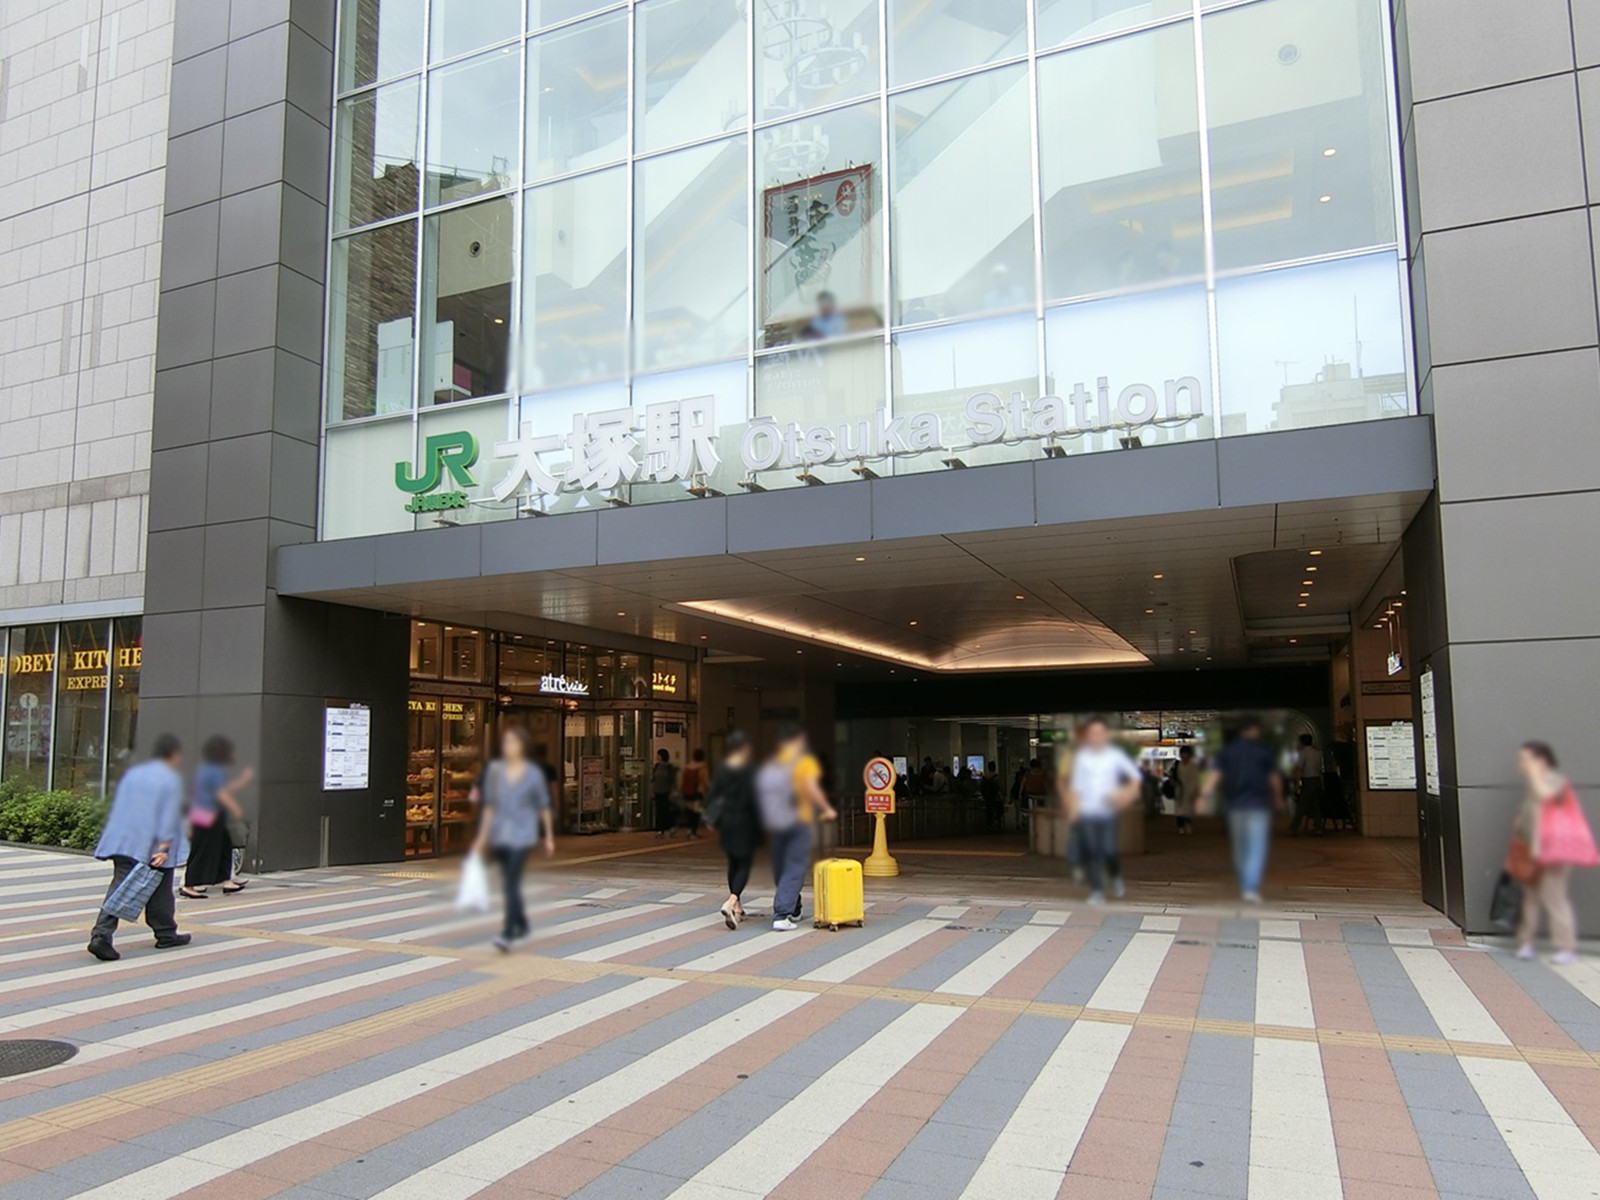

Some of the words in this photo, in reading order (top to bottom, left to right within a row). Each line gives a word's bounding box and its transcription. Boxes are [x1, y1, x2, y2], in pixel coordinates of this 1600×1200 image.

[395, 430, 479, 495] JR
[492, 394, 722, 502] 大塚駅
[741, 406, 943, 472] Ōtsuka
[964, 374, 1205, 445] Station
